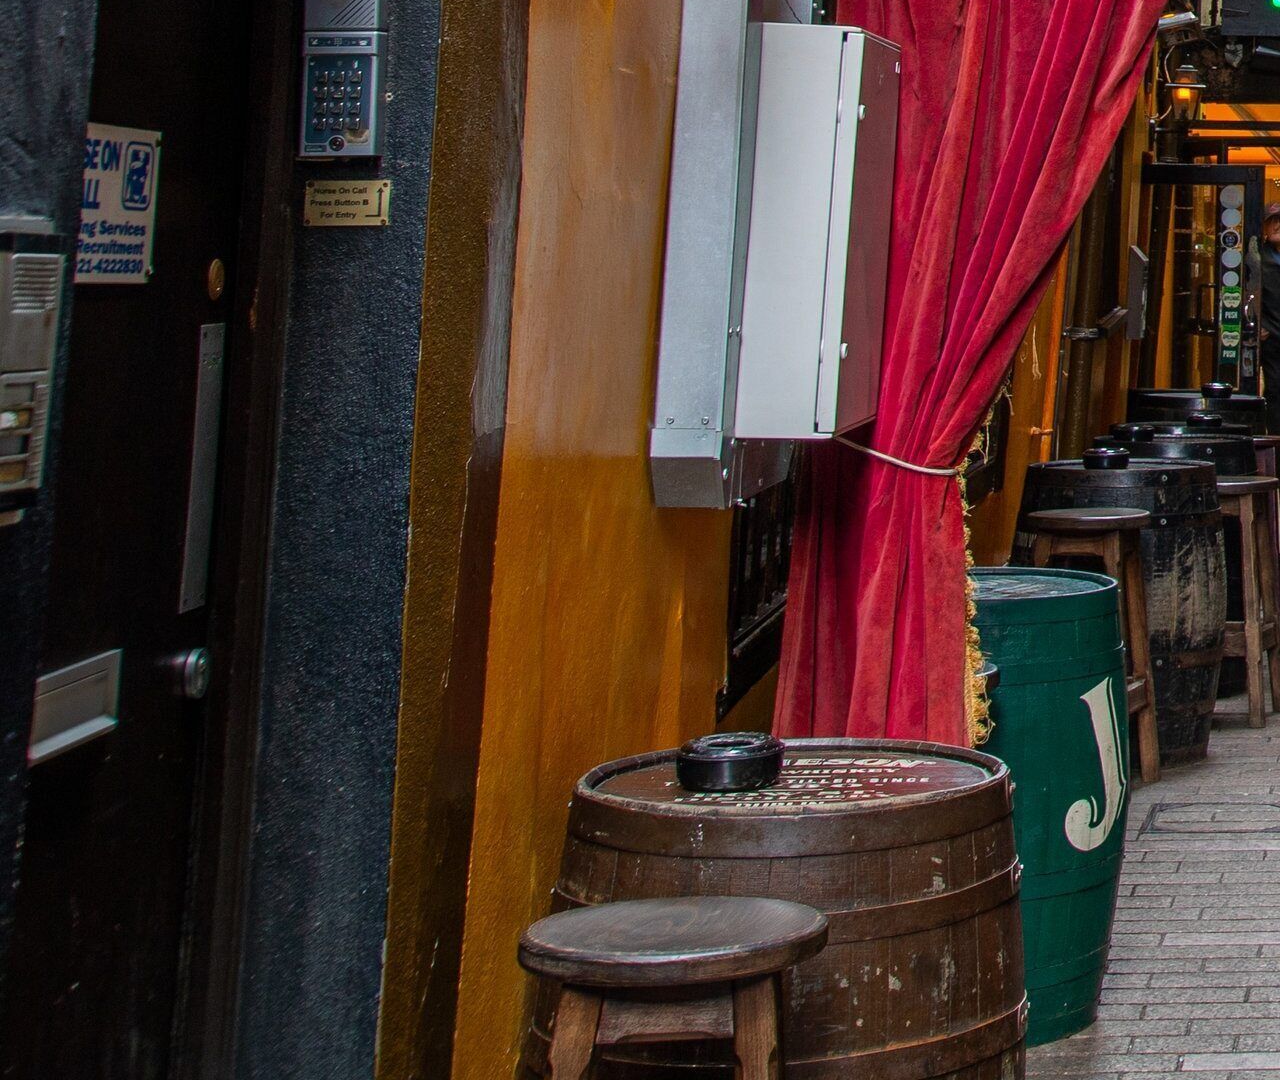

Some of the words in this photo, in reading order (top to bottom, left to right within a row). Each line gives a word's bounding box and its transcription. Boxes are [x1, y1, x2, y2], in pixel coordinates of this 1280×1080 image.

[101, 140, 122, 170] ON
[99, 220, 146, 237] Services
[76, 259, 144, 274] 21-4222830
[783, 758, 922, 768] ESON
